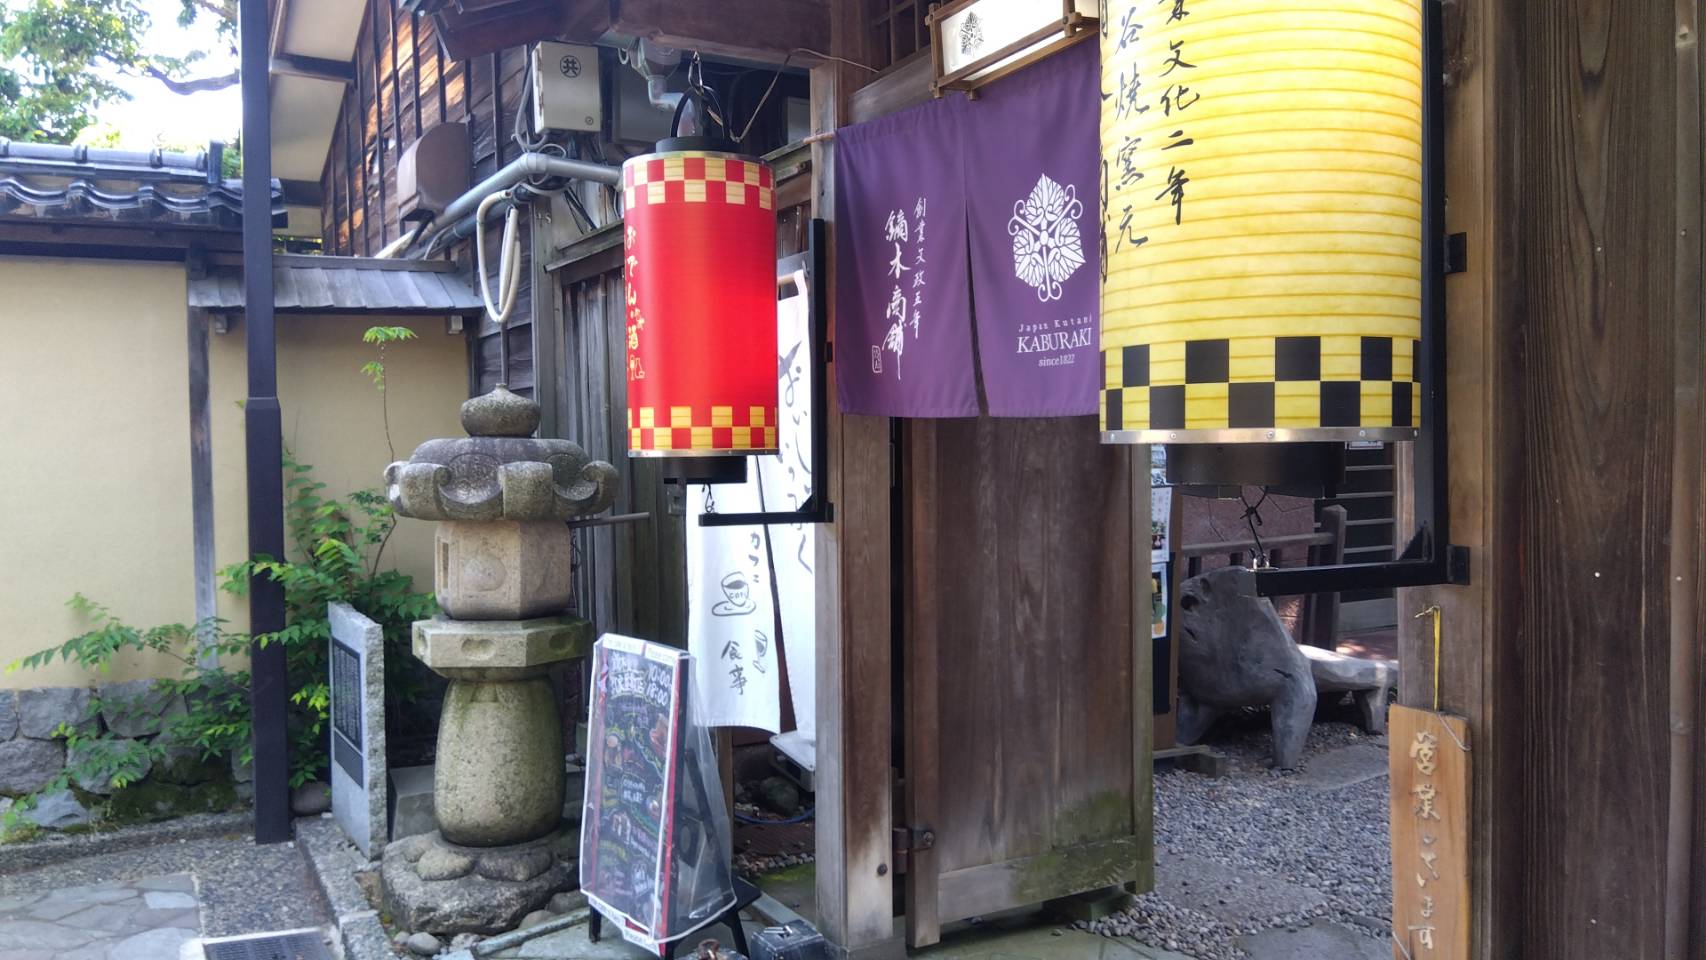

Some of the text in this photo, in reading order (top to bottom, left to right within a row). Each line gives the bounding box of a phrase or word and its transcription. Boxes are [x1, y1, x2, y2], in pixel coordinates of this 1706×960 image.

[1018, 312, 1093, 333] Japan Kutani
[1016, 327, 1092, 353] KABURAKI
[721, 639, 748, 695] 食事
